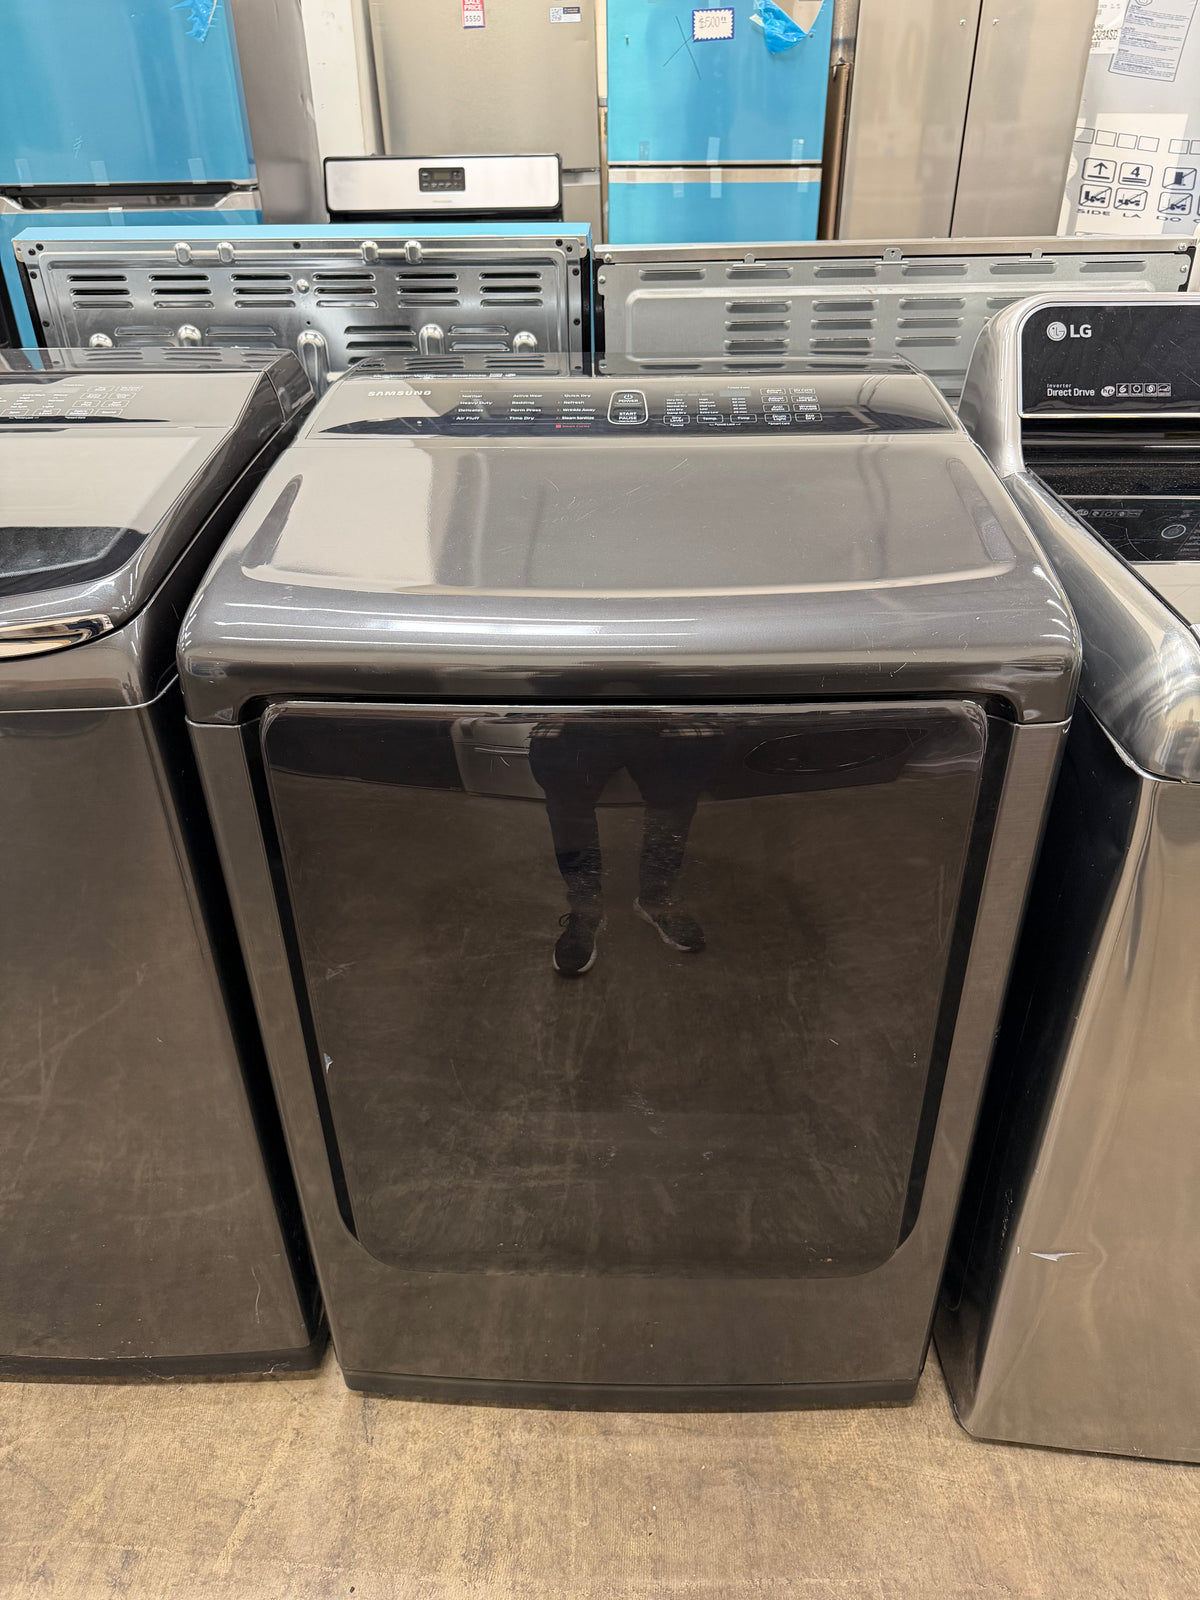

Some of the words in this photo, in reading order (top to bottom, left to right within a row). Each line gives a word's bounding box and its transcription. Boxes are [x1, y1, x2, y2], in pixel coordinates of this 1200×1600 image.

[1077, 208, 1111, 217] SIDE
[1069, 323, 1092, 338] LG
[1047, 388, 1072, 398] Direct
[1073, 388, 1095, 397] Drive
